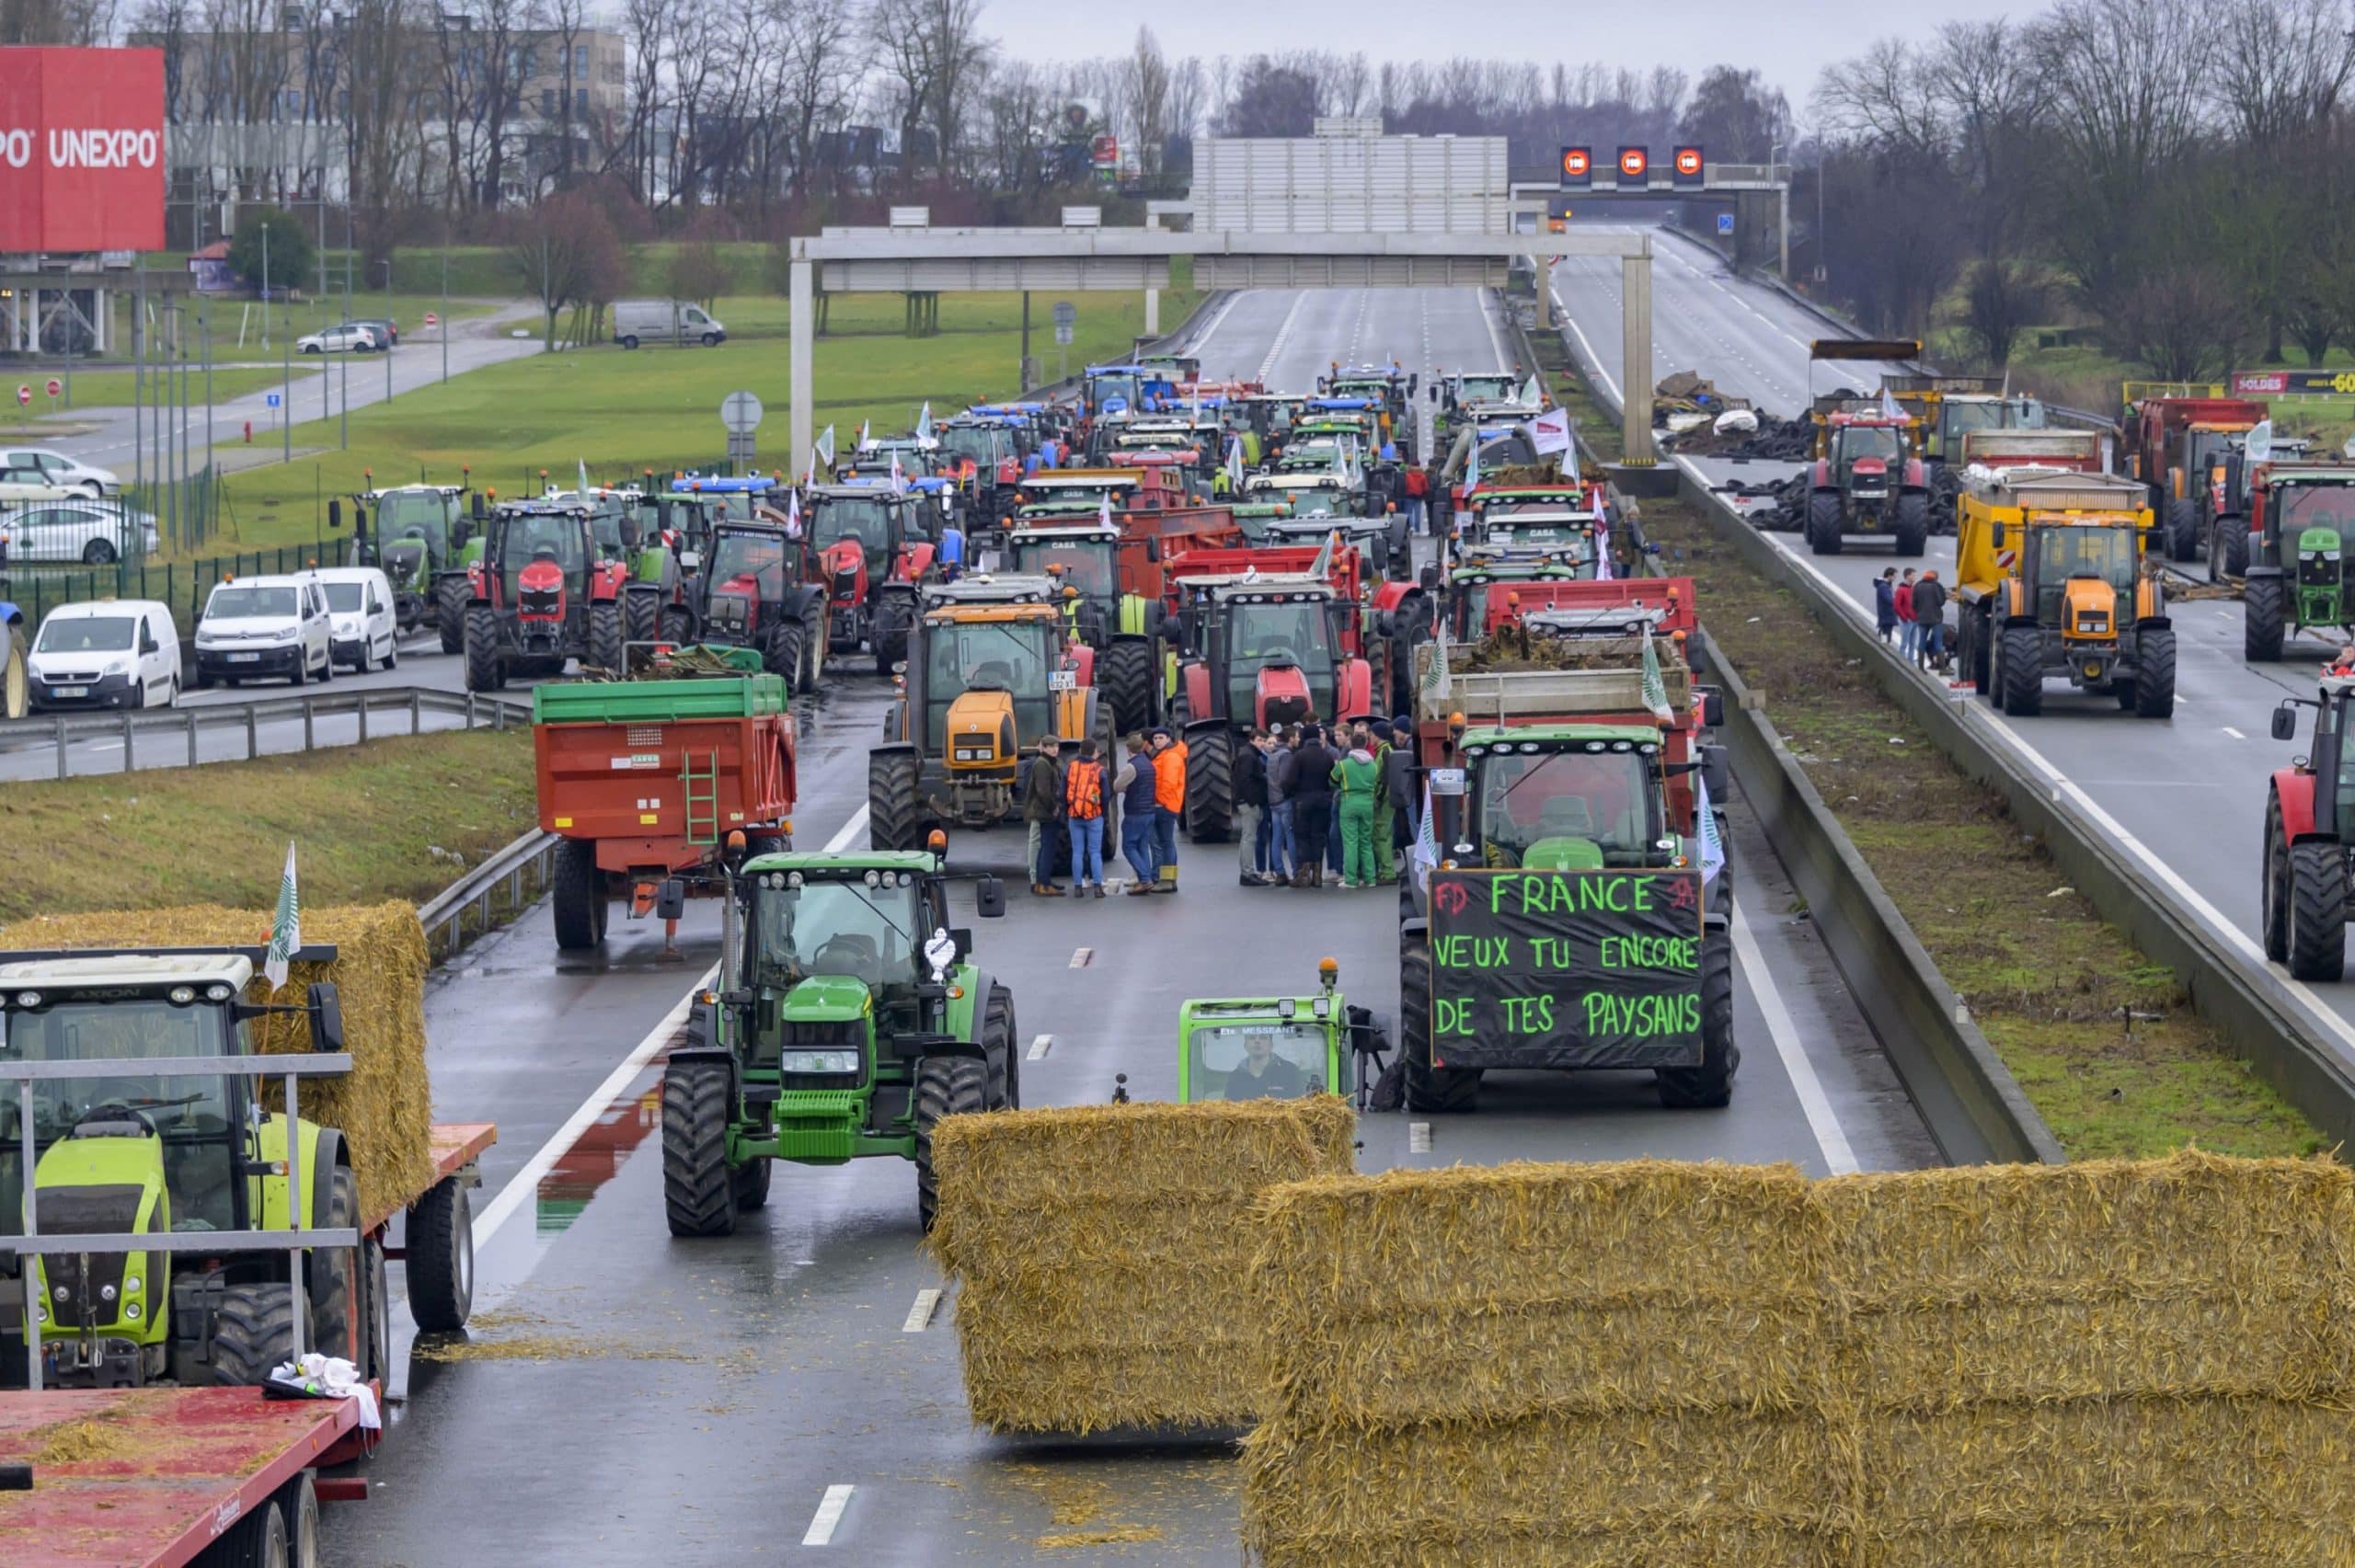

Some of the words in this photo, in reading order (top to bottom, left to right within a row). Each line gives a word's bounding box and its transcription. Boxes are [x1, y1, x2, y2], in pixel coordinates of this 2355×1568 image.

[49, 129, 156, 167] UNEXPO
[1529, 529, 1557, 537] CASA
[1491, 874, 1656, 913] FRANCE
[1434, 934, 1510, 967] VEUX
[1528, 937, 1569, 968] TU
[1601, 932, 1700, 968] ENCORE
[72, 989, 140, 1000] AXION
[1435, 997, 1475, 1035] DE
[1499, 994, 1554, 1033] TES
[1582, 991, 1701, 1036] PAYSANS
